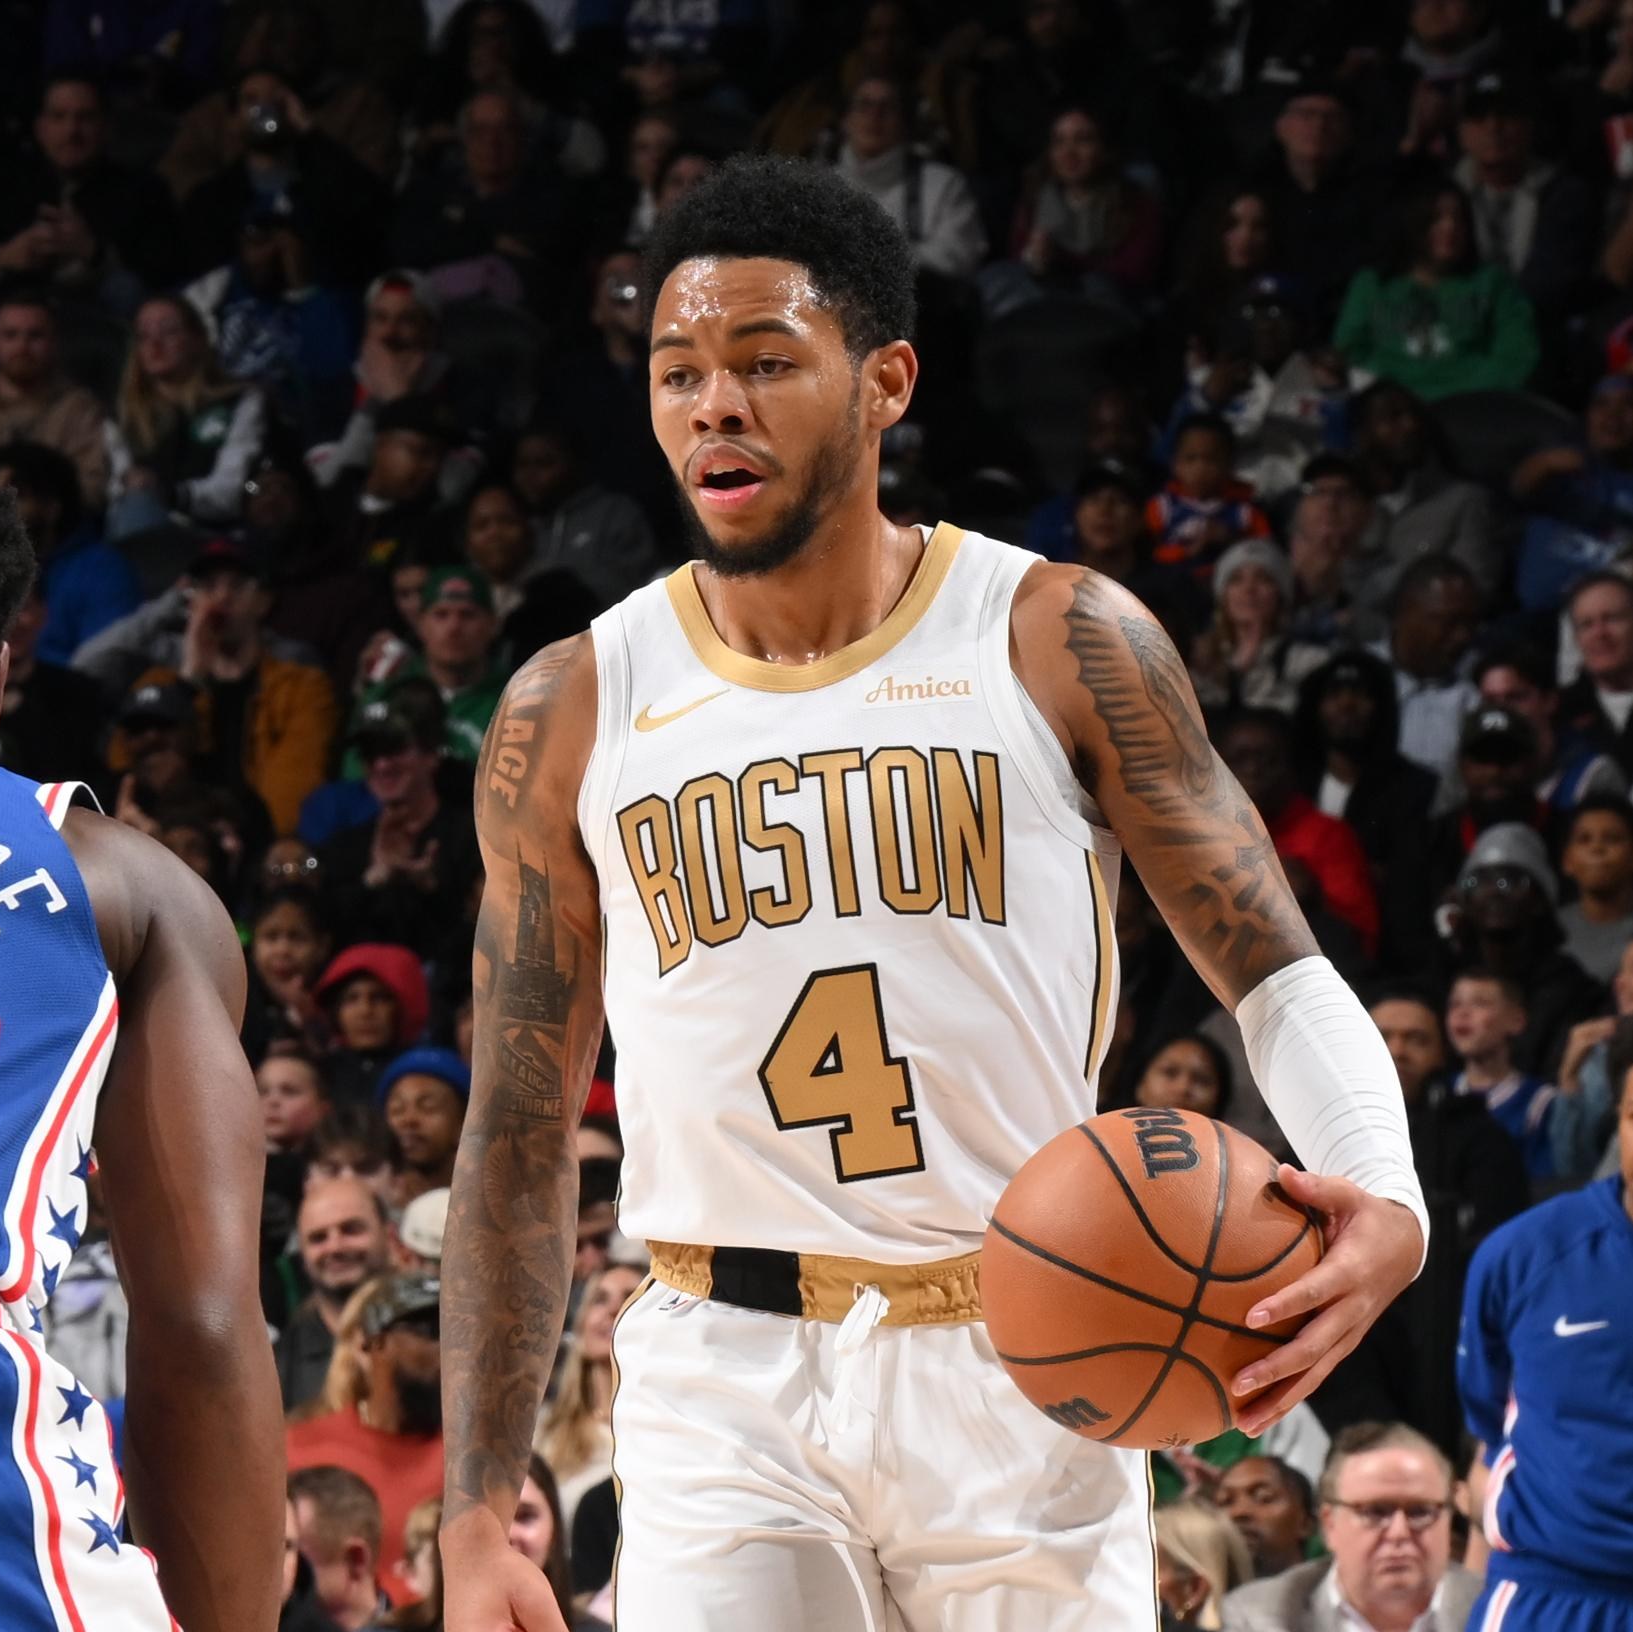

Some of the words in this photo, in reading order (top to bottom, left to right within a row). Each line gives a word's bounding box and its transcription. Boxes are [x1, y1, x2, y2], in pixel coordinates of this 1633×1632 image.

[865, 675, 972, 703] Amica
[616, 746, 1008, 978] BOSTON
[757, 962, 925, 1184] 4
